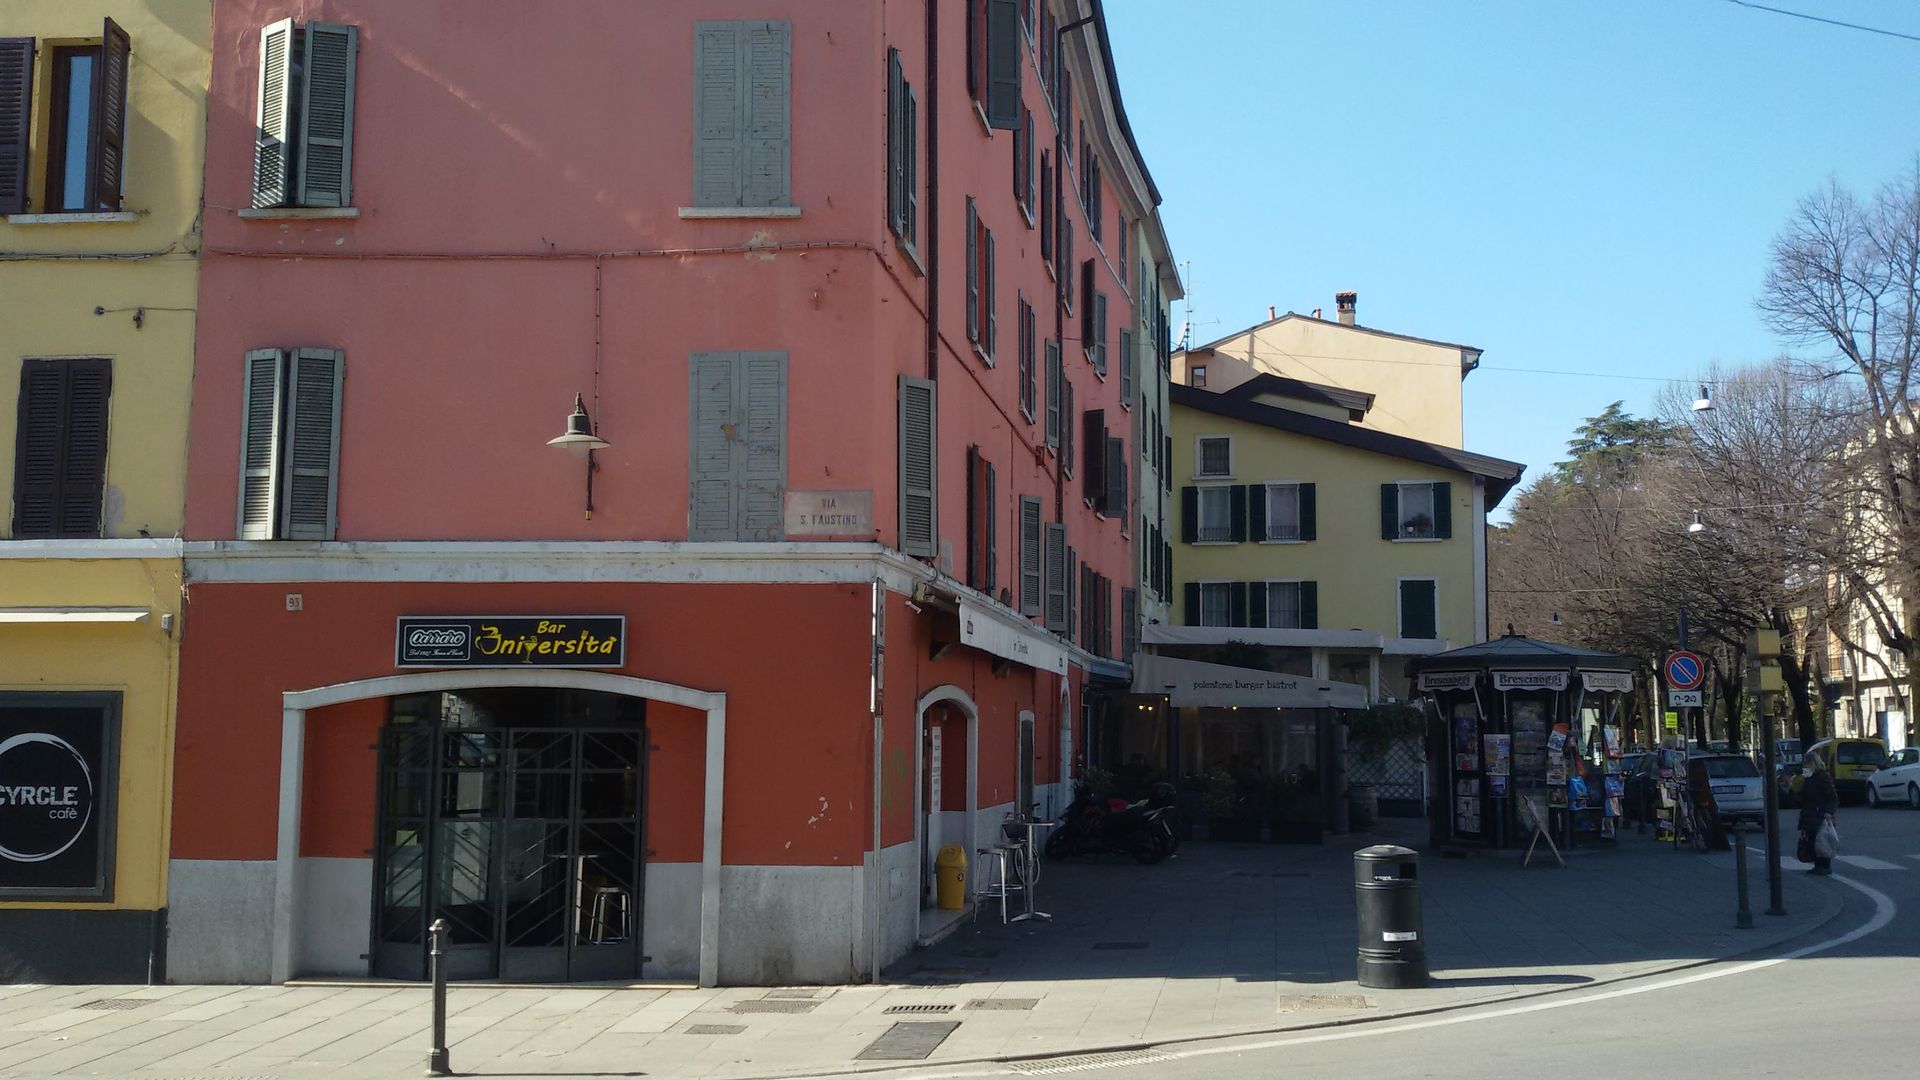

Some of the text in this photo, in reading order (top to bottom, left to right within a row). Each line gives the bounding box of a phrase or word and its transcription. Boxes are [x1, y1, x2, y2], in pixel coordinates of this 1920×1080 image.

[821, 498, 836, 509] VIA
[800, 514, 857, 526] S. FAUSTINO
[536, 620, 567, 635] Bar
[1193, 680, 1297, 690] polentone burger bistrot
[1499, 673, 1562, 687] Bresciaoggi
[49, 807, 77, 819] cafè
